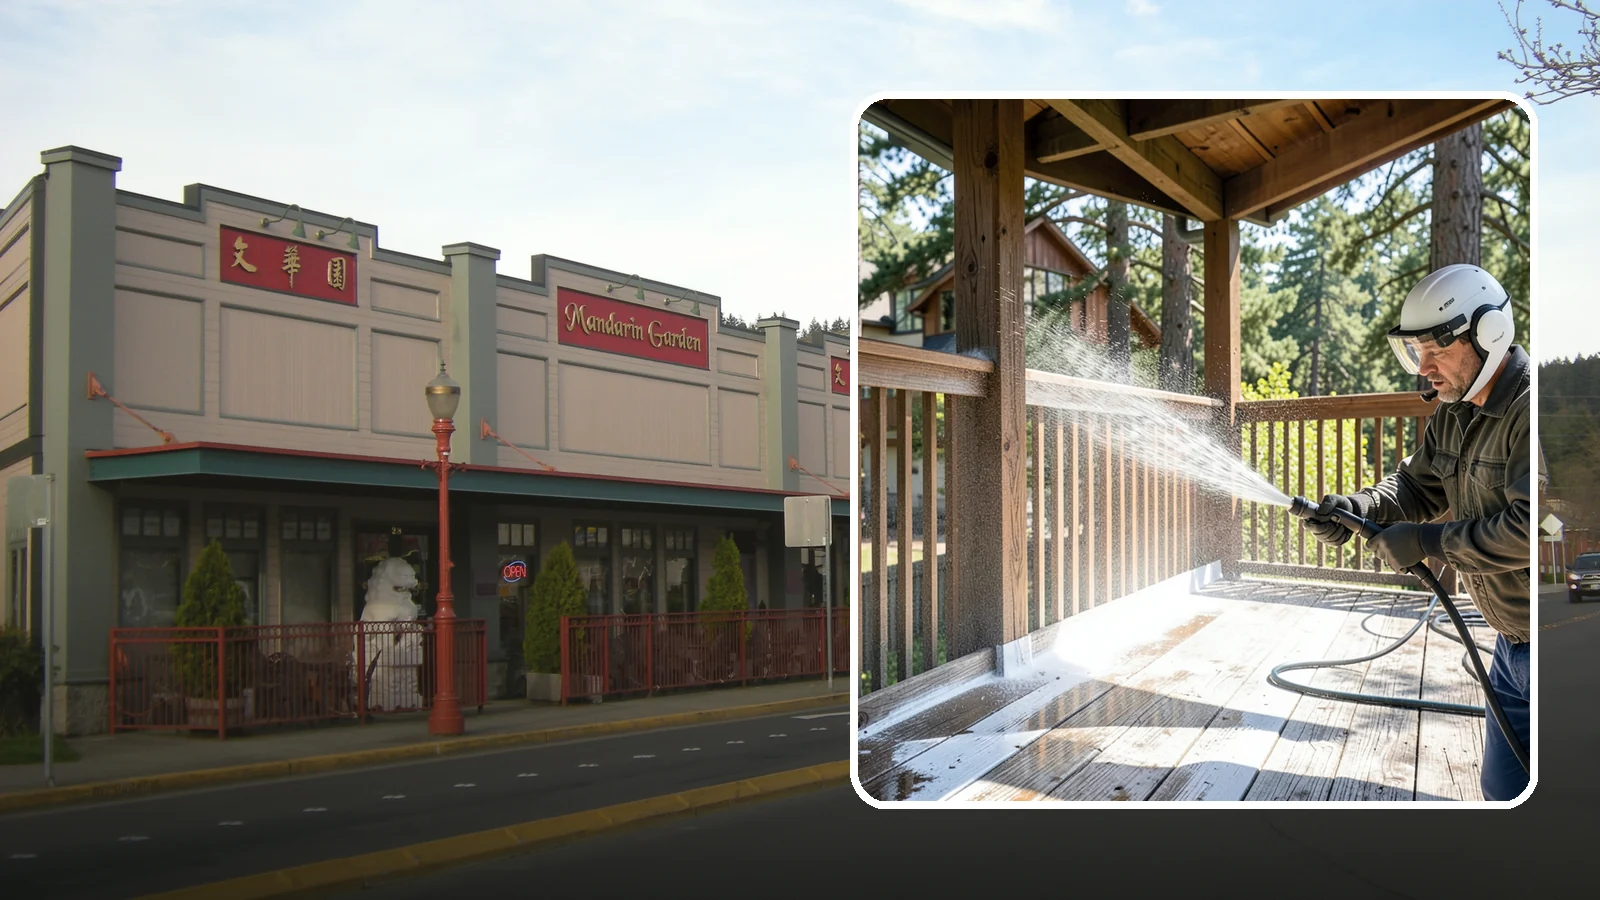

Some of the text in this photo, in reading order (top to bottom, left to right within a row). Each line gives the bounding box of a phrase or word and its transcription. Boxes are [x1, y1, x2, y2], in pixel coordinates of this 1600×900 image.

[230, 235, 346, 291] 文華園
[564, 302, 702, 352] Mandarin Garden
[503, 565, 527, 578] OPEN
